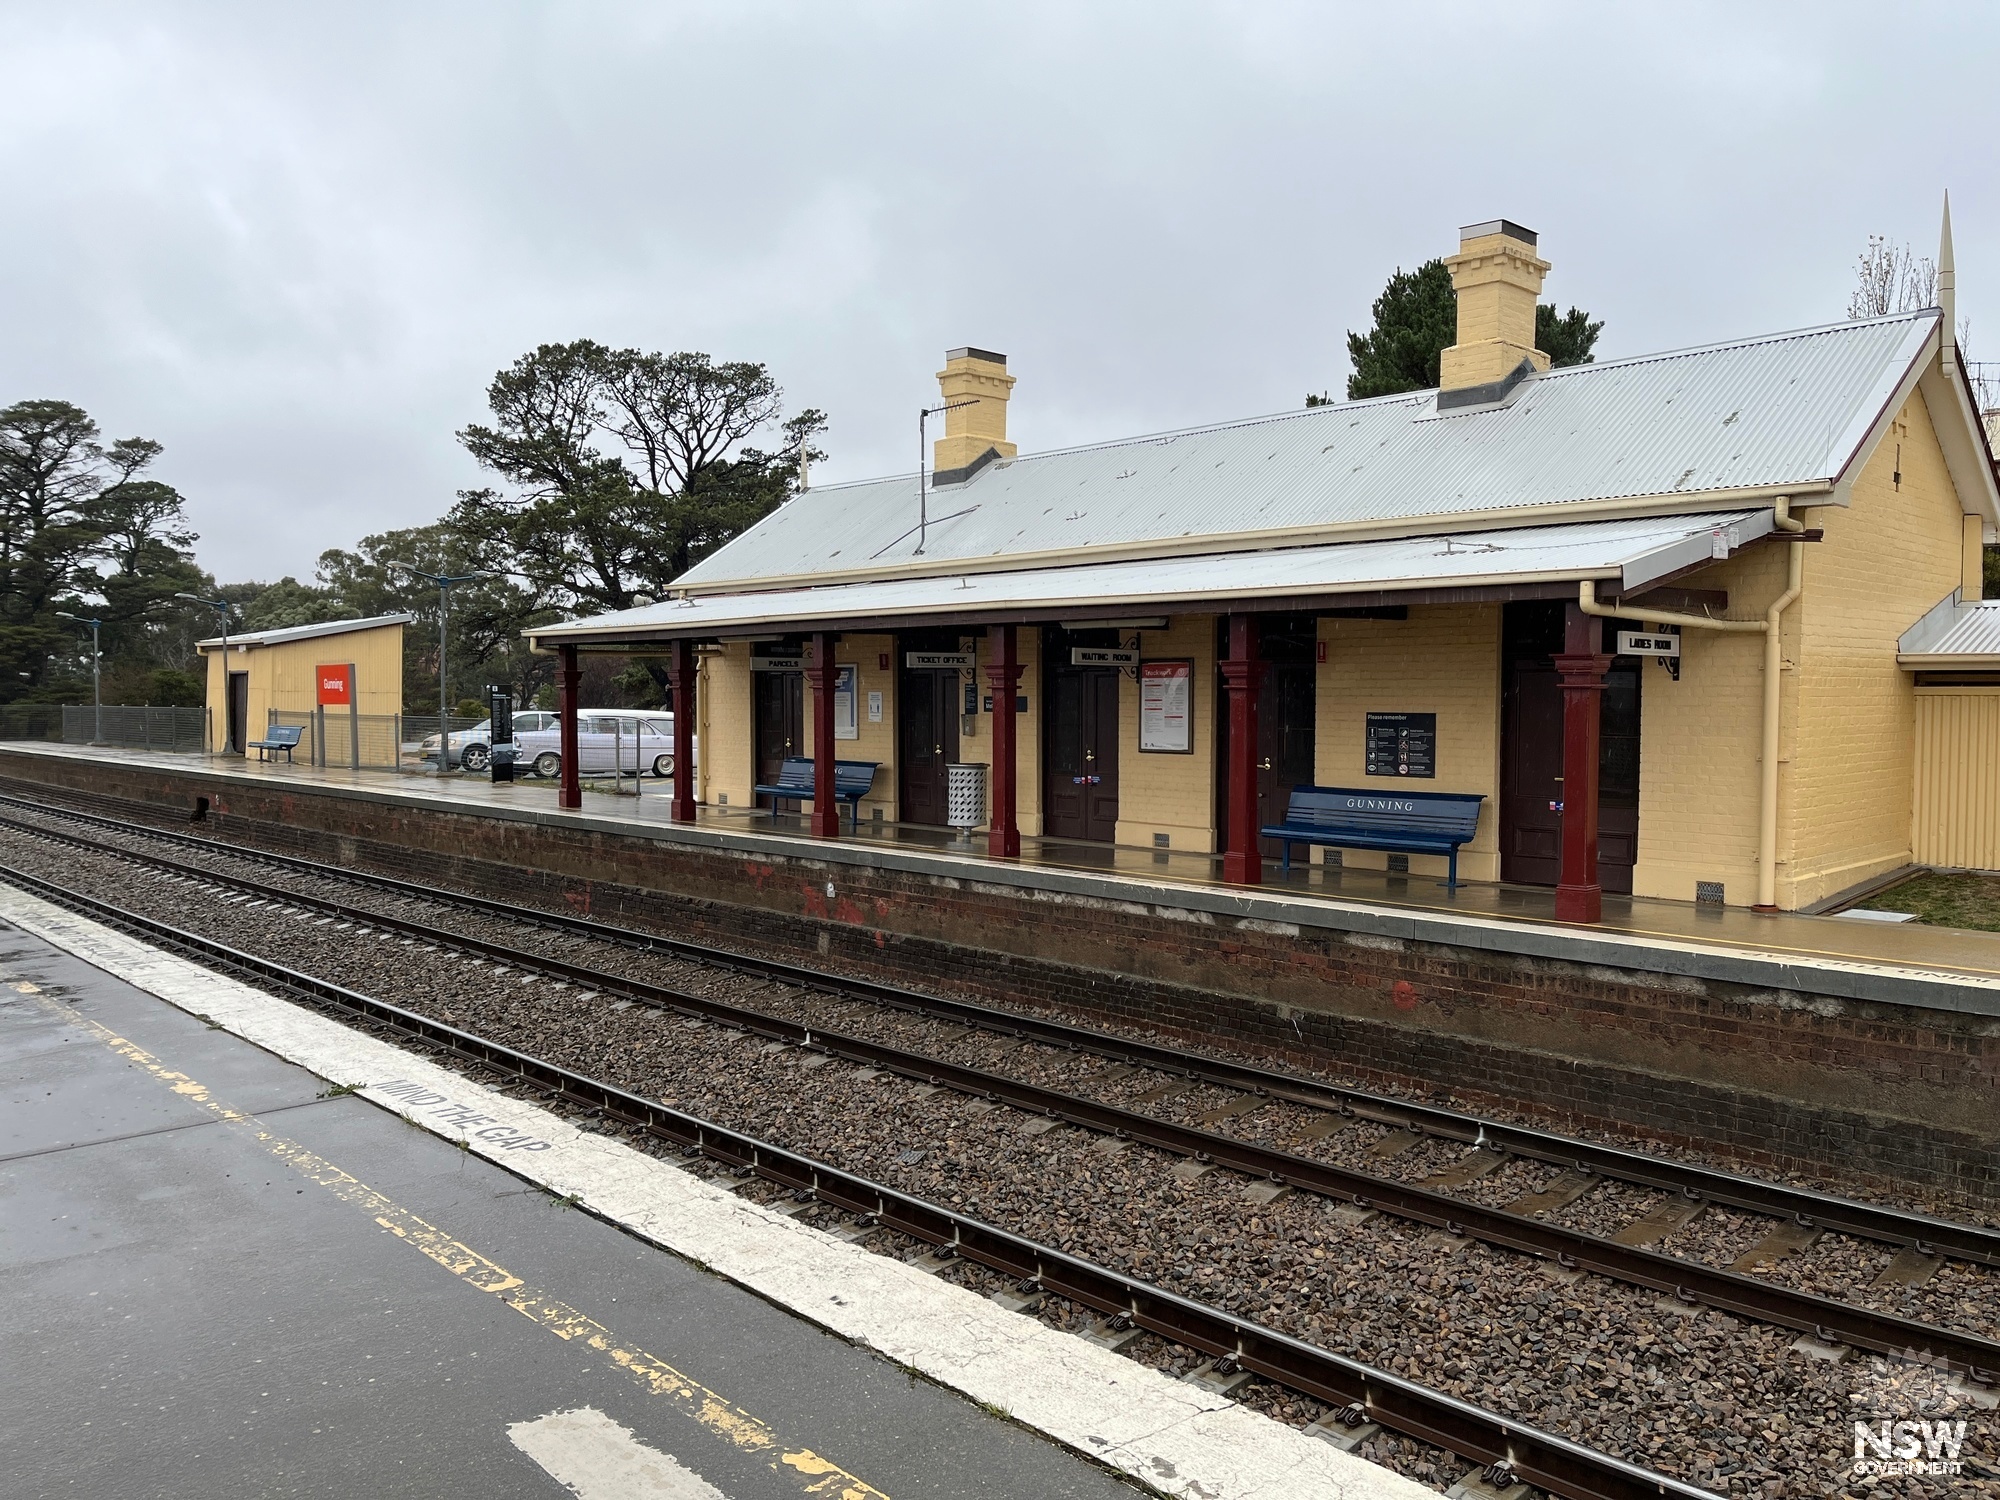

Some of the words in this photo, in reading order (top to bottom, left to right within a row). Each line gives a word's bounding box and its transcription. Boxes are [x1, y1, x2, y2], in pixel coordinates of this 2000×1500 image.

[1629, 637, 1652, 649] LADIES
[1654, 639, 1672, 650] ROOM
[916, 656, 941, 664] TICKET
[943, 656, 968, 664] OFFICE
[1112, 653, 1132, 662] ROOM
[323, 678, 344, 692] Gunning
[1346, 798, 1414, 812] GUNNING
[372, 1079, 448, 1106] MIND
[428, 1103, 498, 1130] THE
[474, 1126, 552, 1152] GAP
